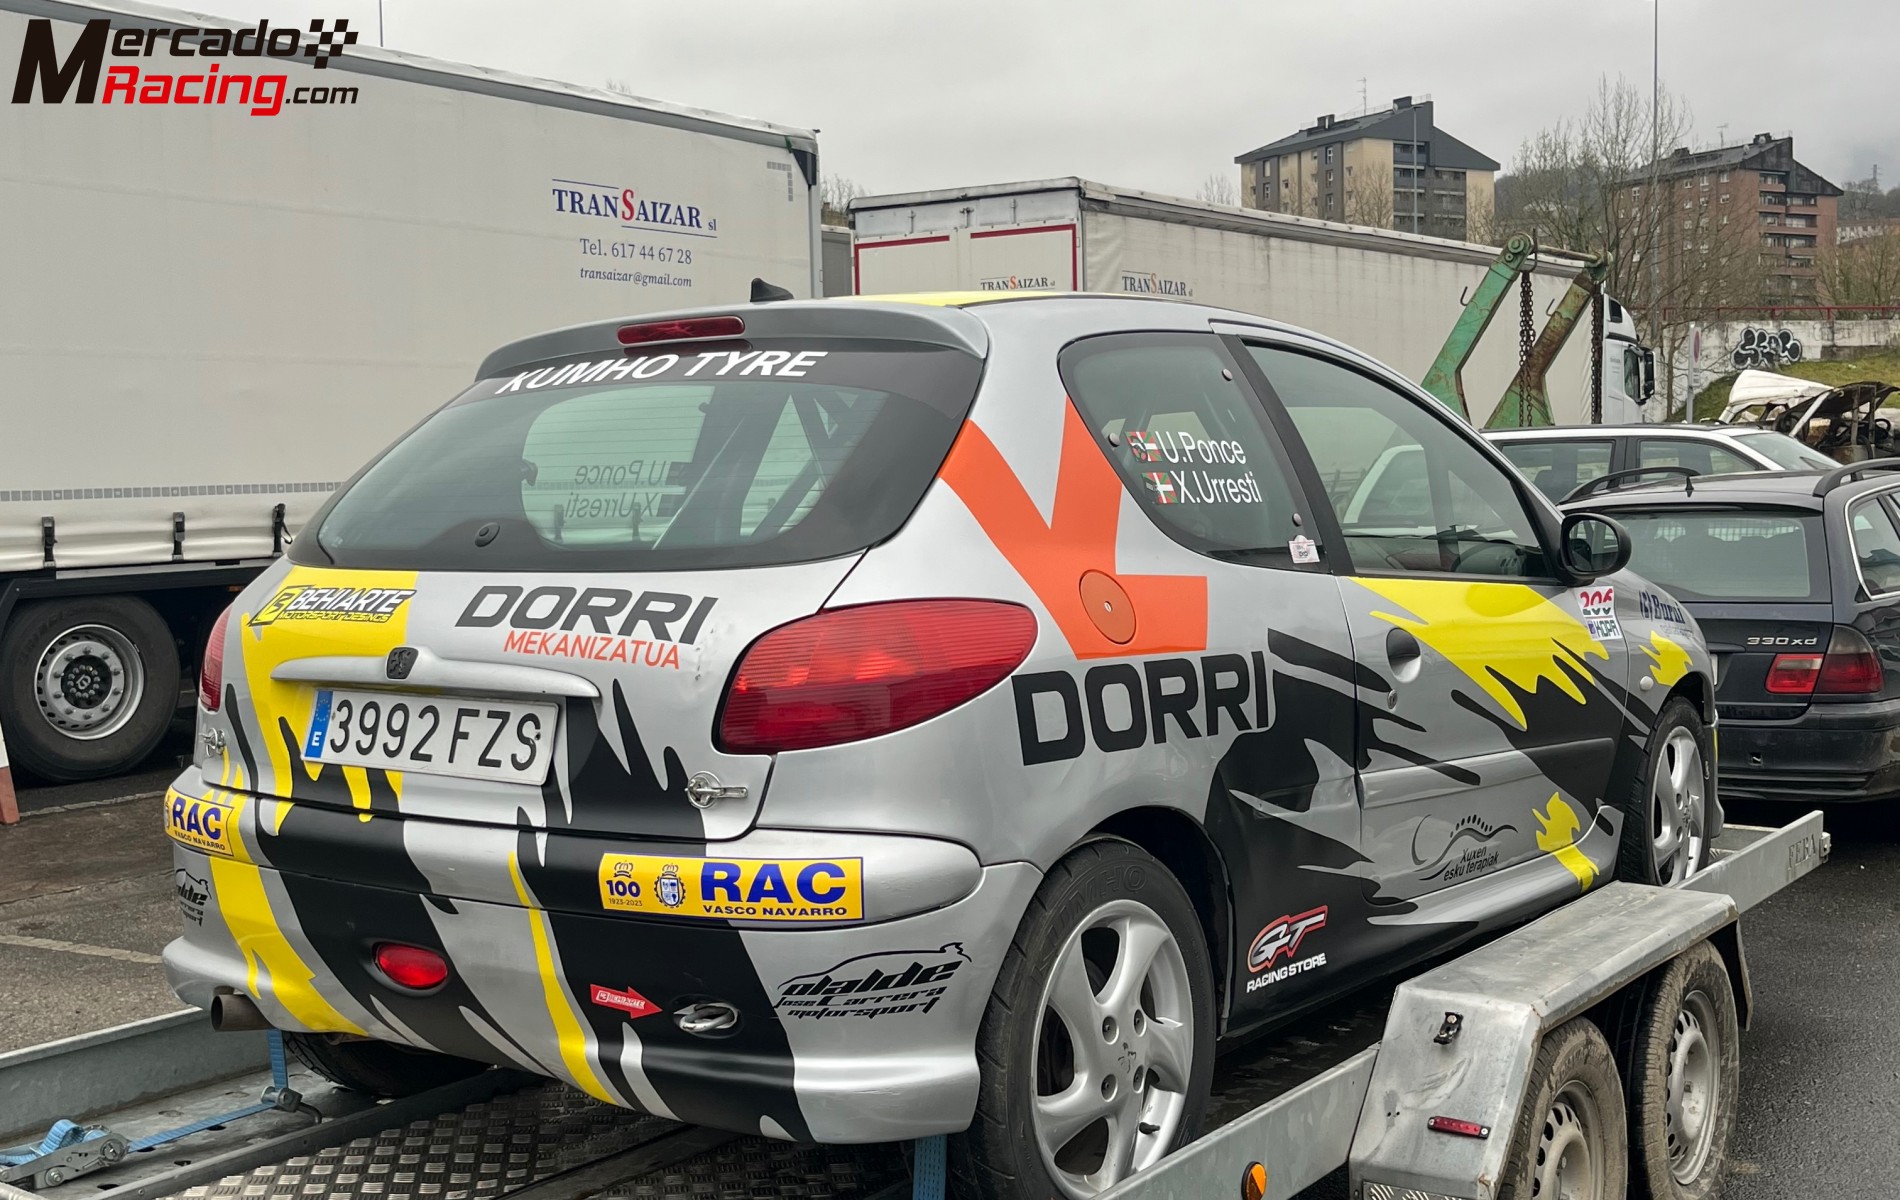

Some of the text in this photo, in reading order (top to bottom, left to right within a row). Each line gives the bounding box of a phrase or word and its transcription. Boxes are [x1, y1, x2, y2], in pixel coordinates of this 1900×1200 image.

[708, 219, 717, 231] sl
[580, 238, 692, 265] Tel. 617 44 67 28
[580, 267, 692, 288] transaizar@gmail.com
[495, 351, 828, 394] KUMHO TYRE
[1155, 431, 1246, 464] U.Ponce
[1170, 470, 1263, 504] X.Urresti
[286, 587, 417, 613] BEHIARTE
[455, 586, 719, 645] DORRI
[504, 630, 680, 670] MEKANIZATUA
[1011, 651, 1268, 766] DORRI
[311, 699, 541, 771] E 3992 FZS
[173, 797, 221, 840] RAC
[1443, 851, 1499, 881] esku terapiak
[606, 880, 640, 897] 100
[700, 862, 846, 904] RAC
[609, 898, 642, 906] 1923-2023
[703, 905, 847, 916] VASCO NAVARRO
[787, 997, 940, 1019] motorsport
